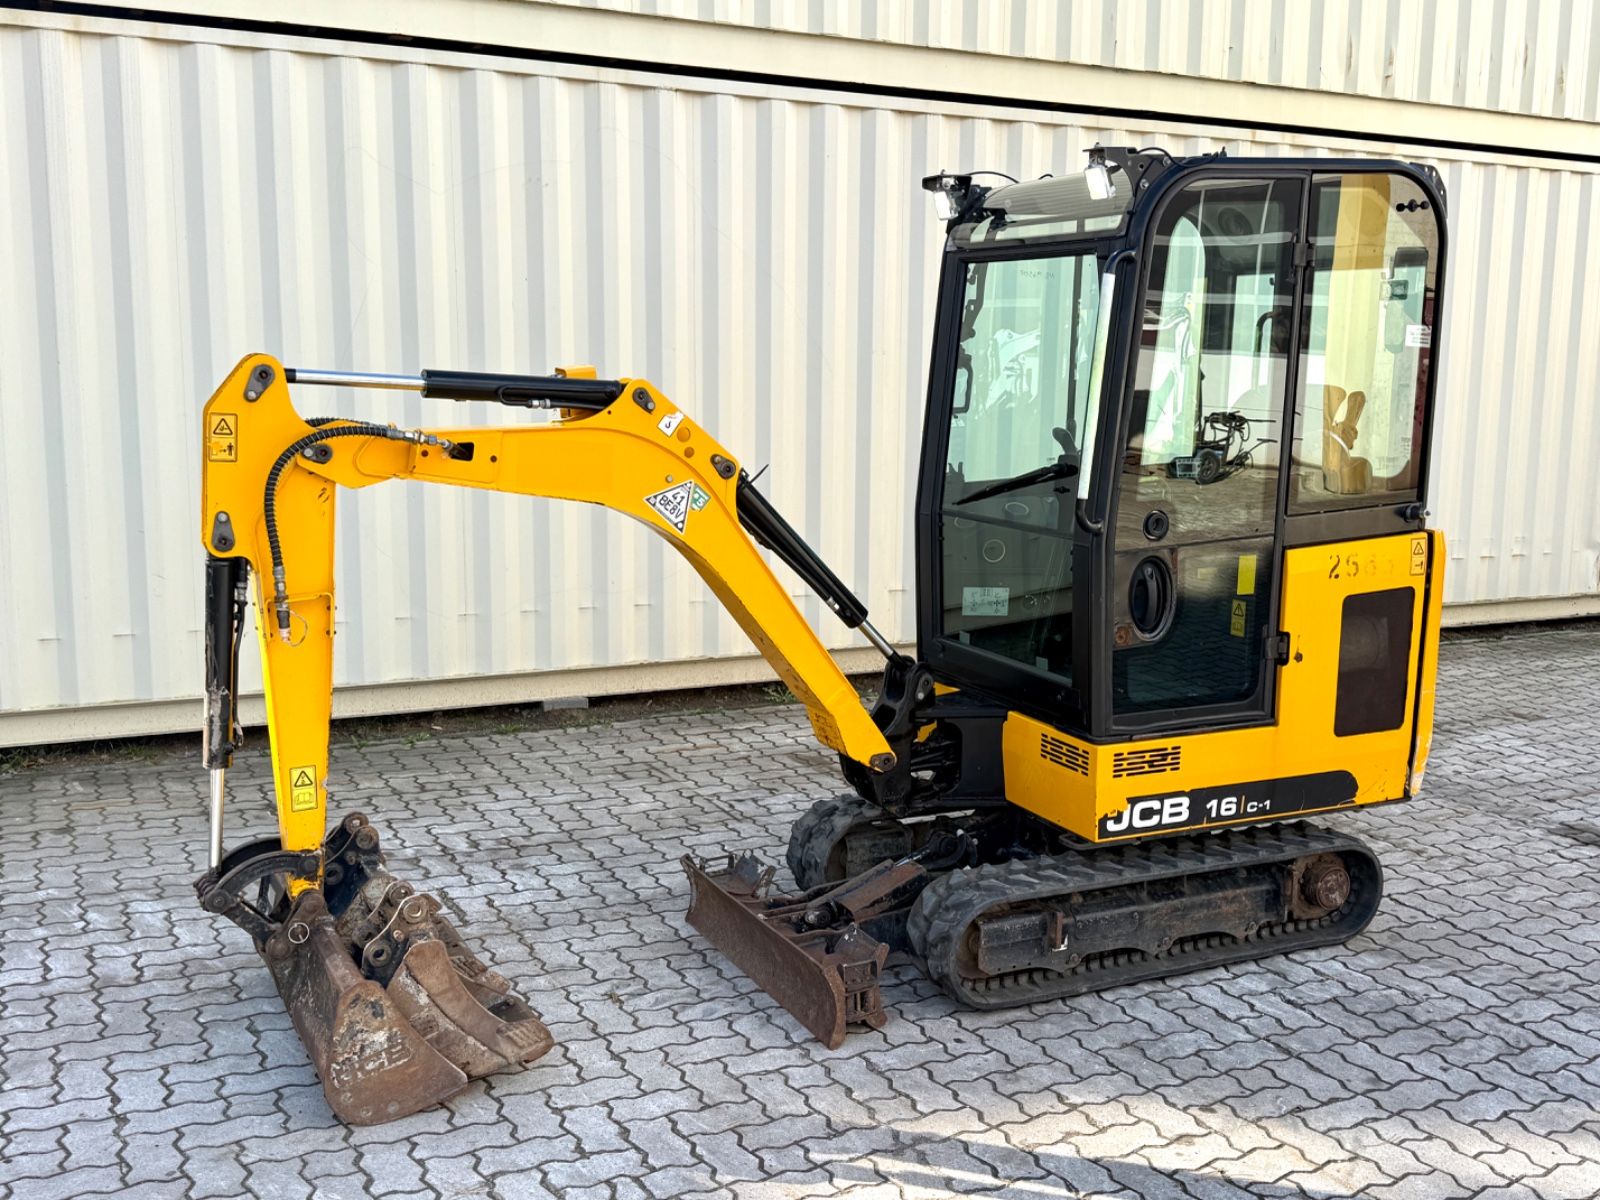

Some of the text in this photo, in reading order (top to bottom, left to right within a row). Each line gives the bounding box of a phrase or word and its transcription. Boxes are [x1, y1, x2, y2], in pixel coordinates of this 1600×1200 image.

[658, 495, 684, 519] BE8V
[672, 491, 685, 506] 41
[1106, 796, 1190, 832] JCB
